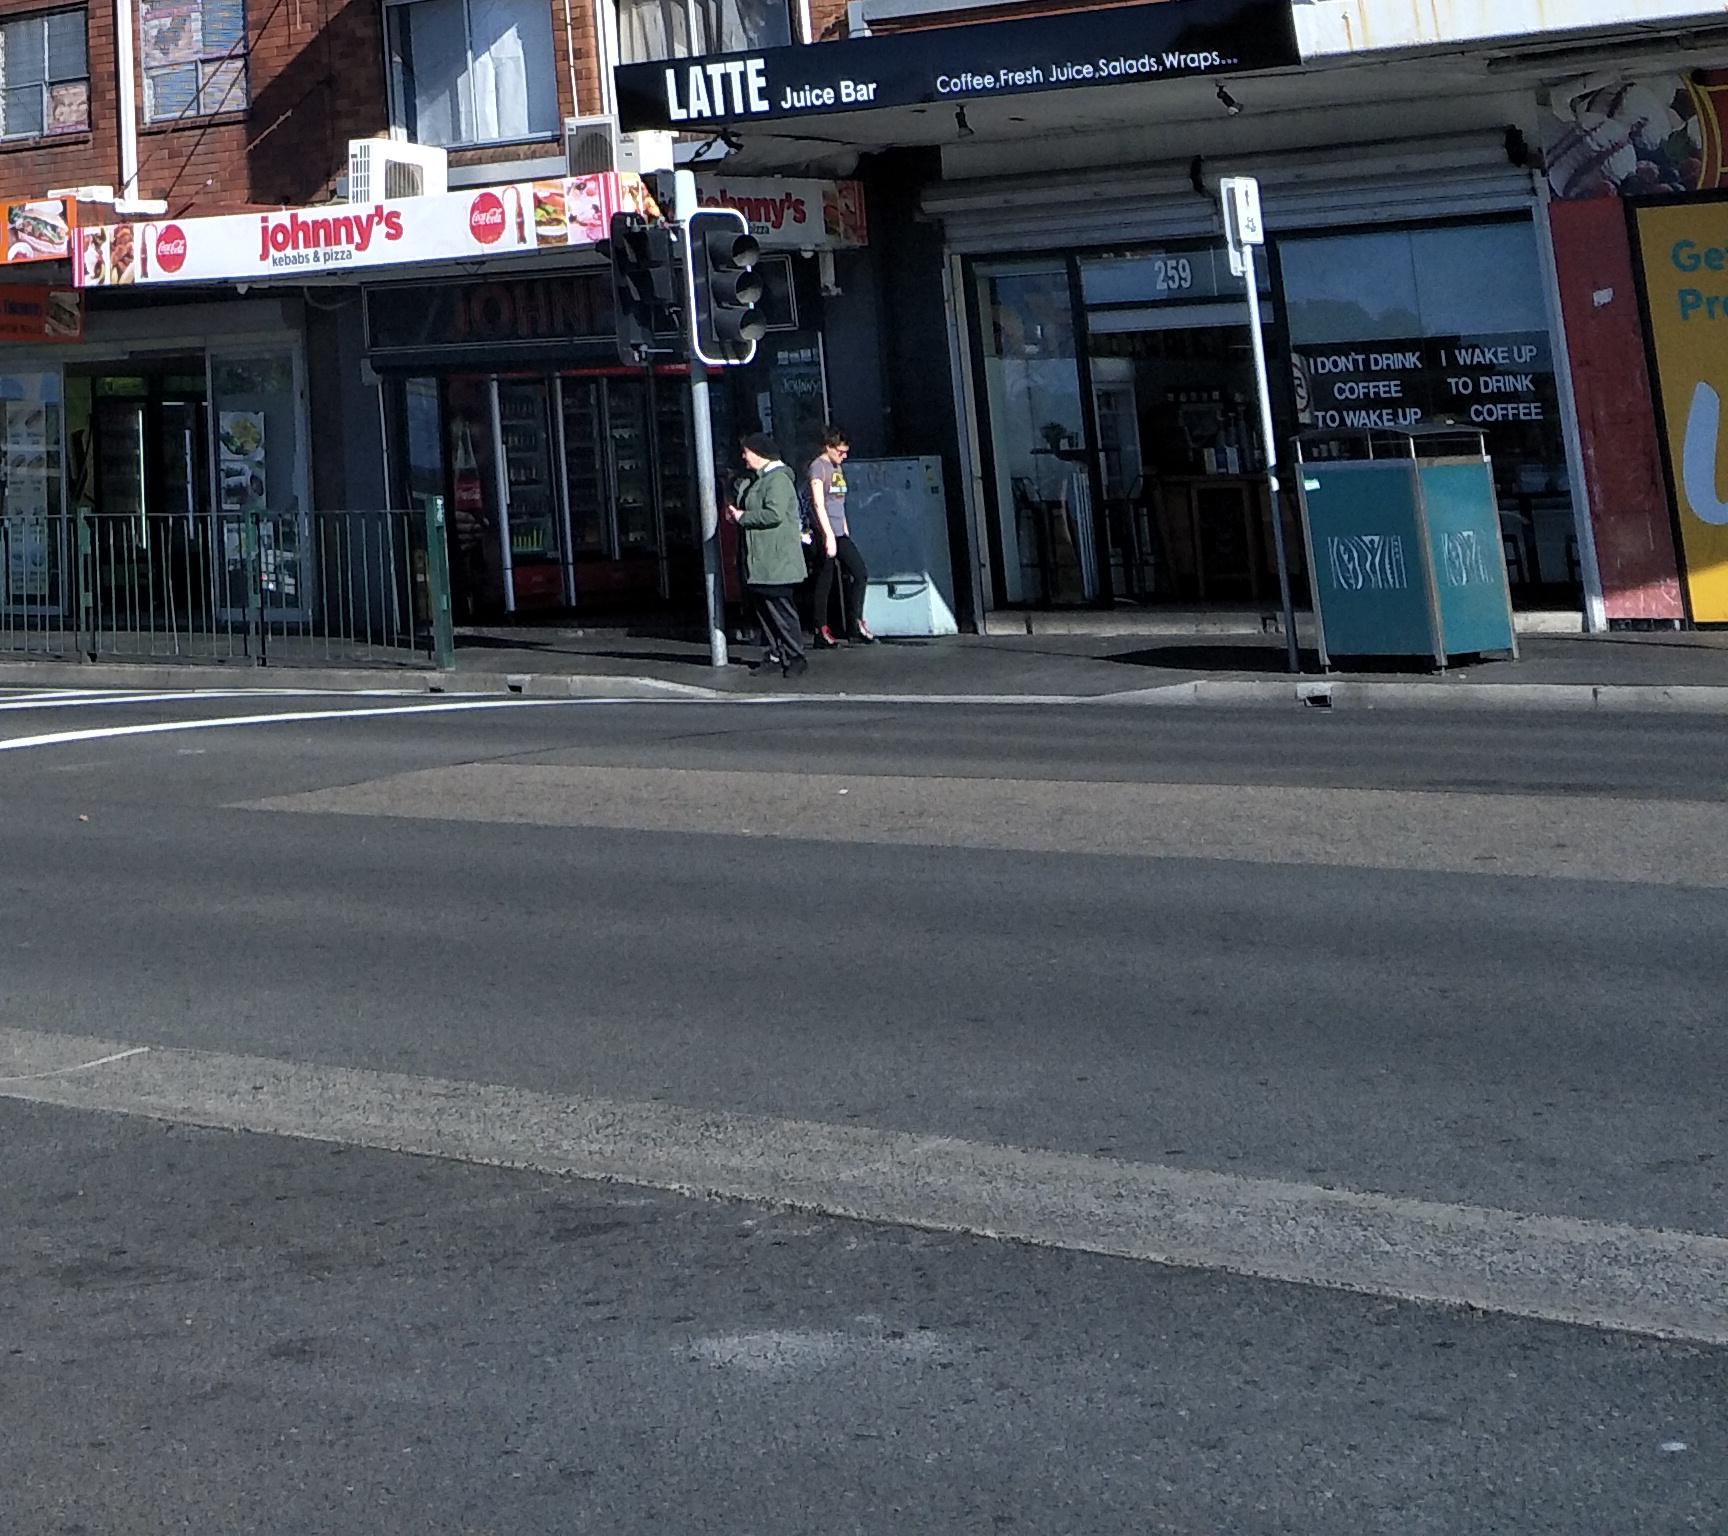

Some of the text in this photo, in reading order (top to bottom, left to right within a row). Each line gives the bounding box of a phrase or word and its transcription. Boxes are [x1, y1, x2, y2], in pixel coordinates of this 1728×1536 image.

[665, 58, 770, 121] LATTE
[780, 85, 835, 109] Juice
[840, 80, 877, 103] Bar
[259, 204, 404, 261] johnny's
[272, 249, 352, 267] kebabs & pizza
[1671, 239, 1728, 273] Ge
[1154, 258, 1192, 290] 259
[1309, 351, 1422, 374] I DON'T DRINK
[1441, 345, 1537, 366] I WAKE UP
[1333, 380, 1403, 400] COFFEE
[1447, 374, 1535, 395] TO DRINK
[1314, 407, 1422, 429] TO WAKE UP
[1471, 402, 1544, 422] COFFEE
